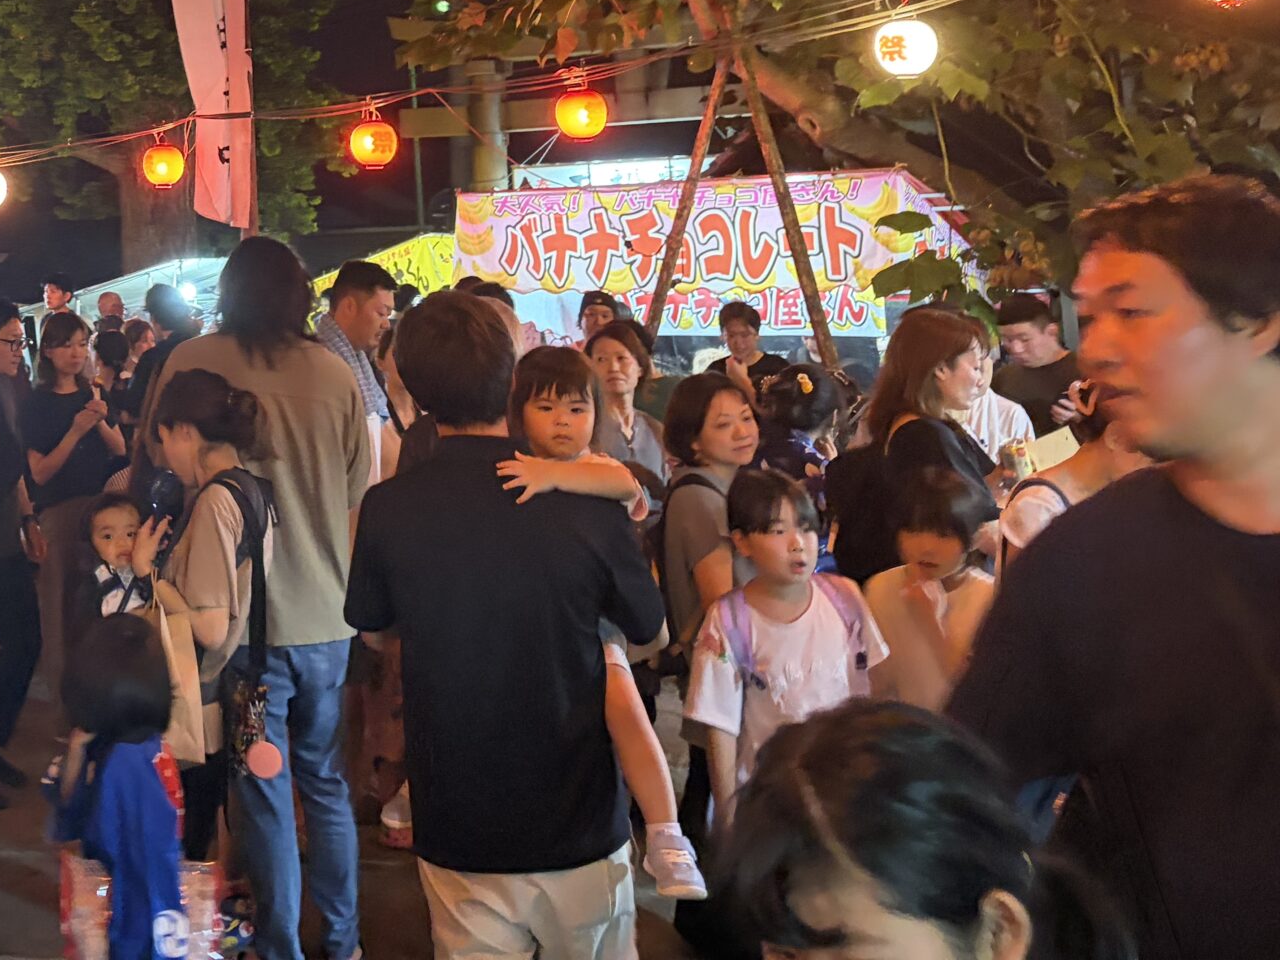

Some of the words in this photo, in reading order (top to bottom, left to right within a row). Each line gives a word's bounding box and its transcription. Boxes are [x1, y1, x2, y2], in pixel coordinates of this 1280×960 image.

[879, 35, 907, 61] 祭
[502, 202, 863, 287] バナナチョコレート
